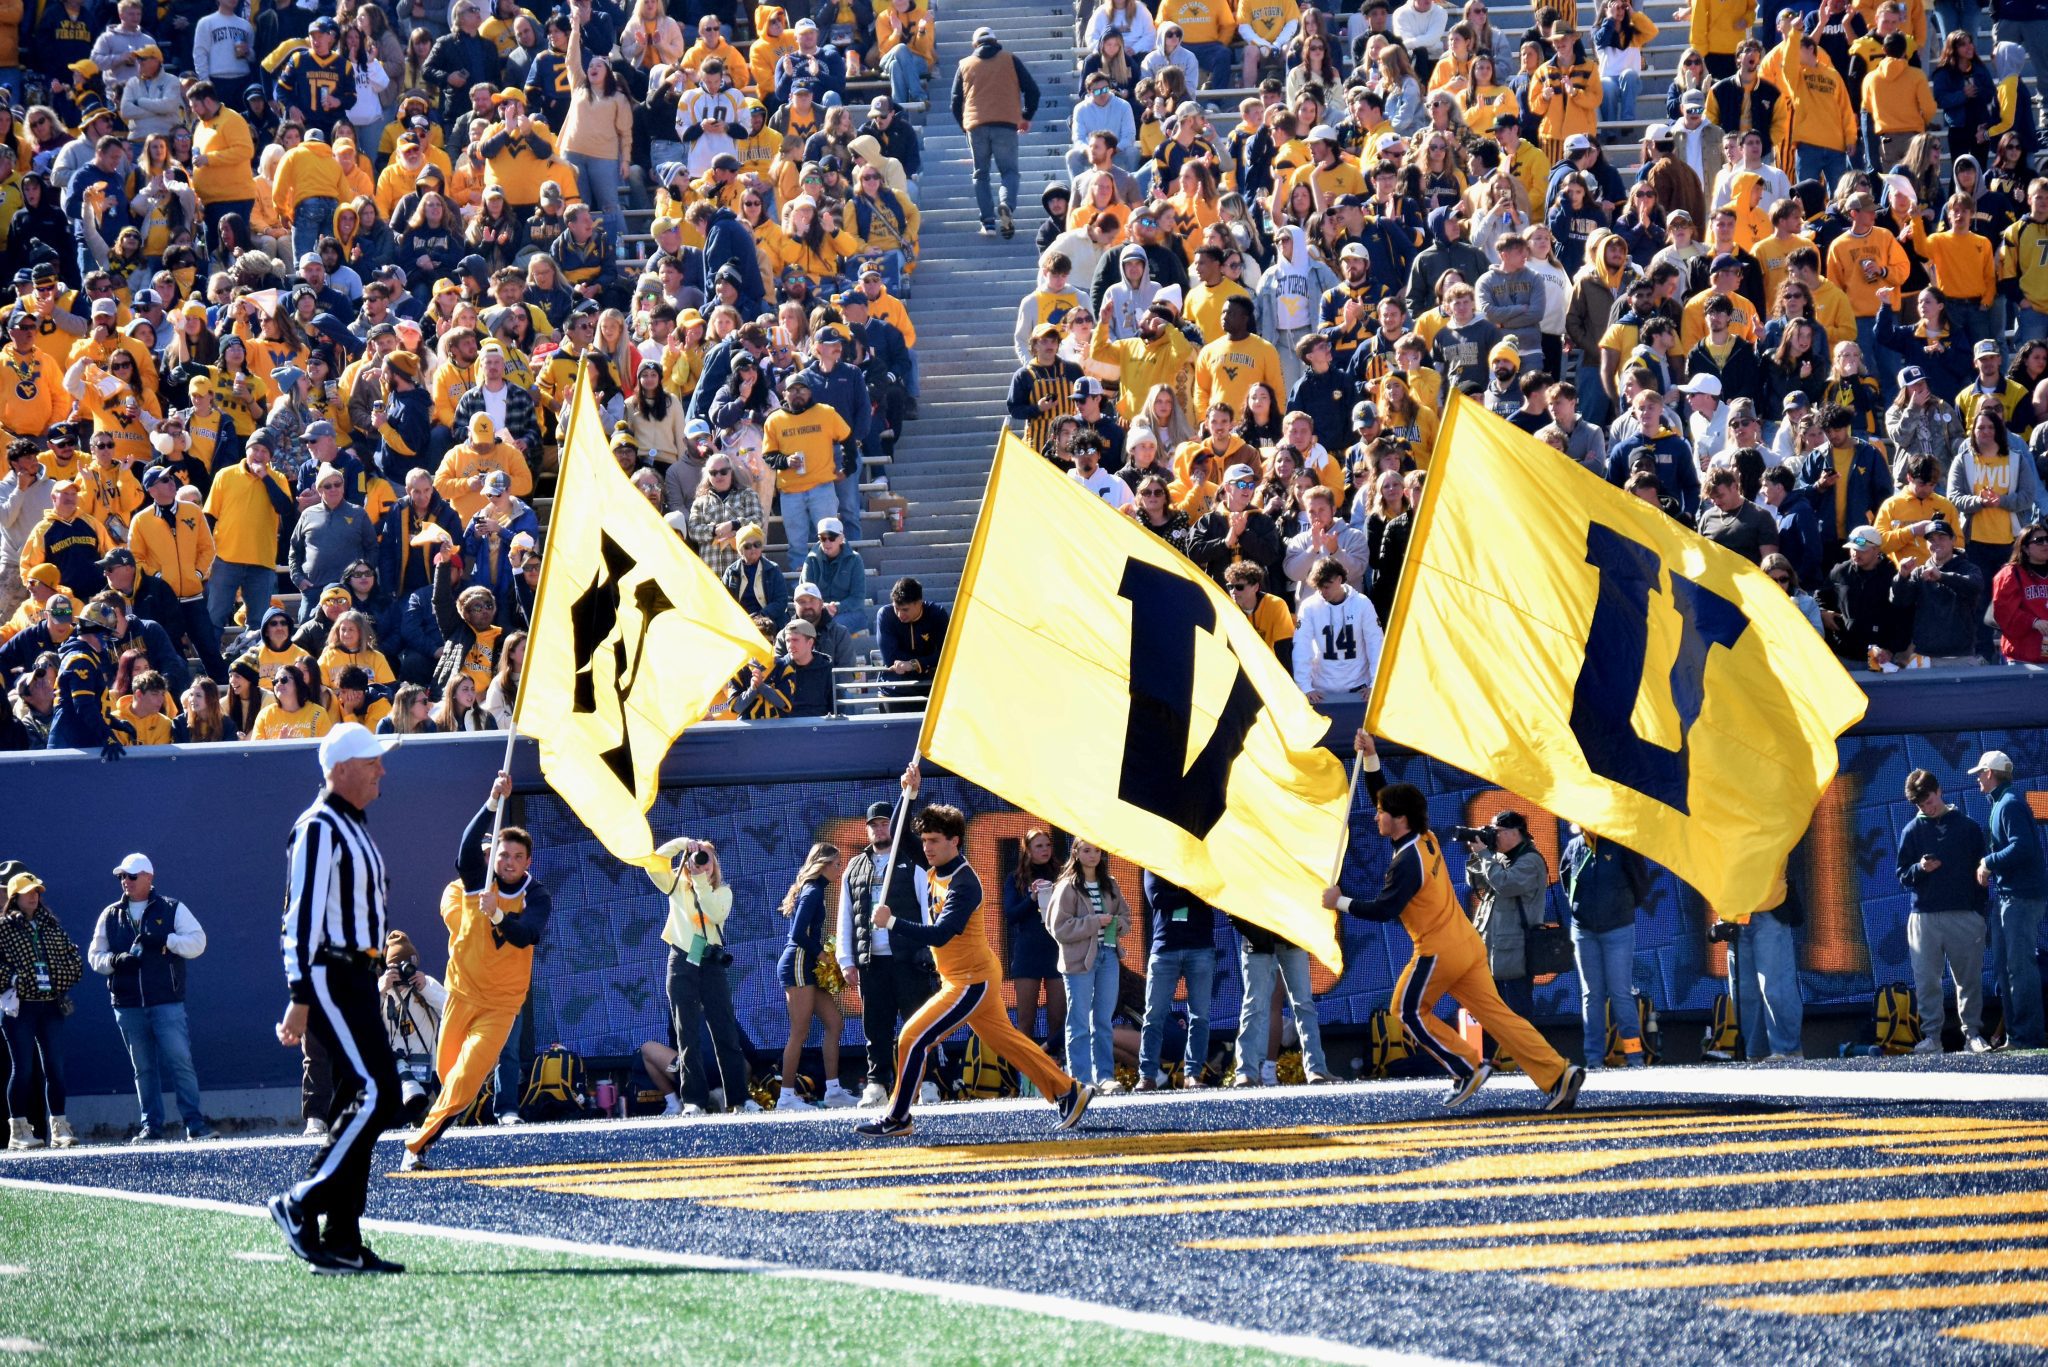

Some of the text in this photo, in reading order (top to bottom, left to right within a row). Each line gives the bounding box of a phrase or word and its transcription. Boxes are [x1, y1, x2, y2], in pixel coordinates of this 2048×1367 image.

[60, 20, 87, 31] WEST
[56, 29, 91, 42] VIRGINIA
[212, 27, 228, 43] WEST
[1229, 353, 1256, 368] VIRGINIA
[782, 424, 822, 438] WEST VIRGINIA
[1974, 463, 2009, 487] WVU
[50, 536, 97, 554] MOUNTAINEERS
[1322, 624, 1356, 660] 14
[1569, 520, 1750, 817] U
